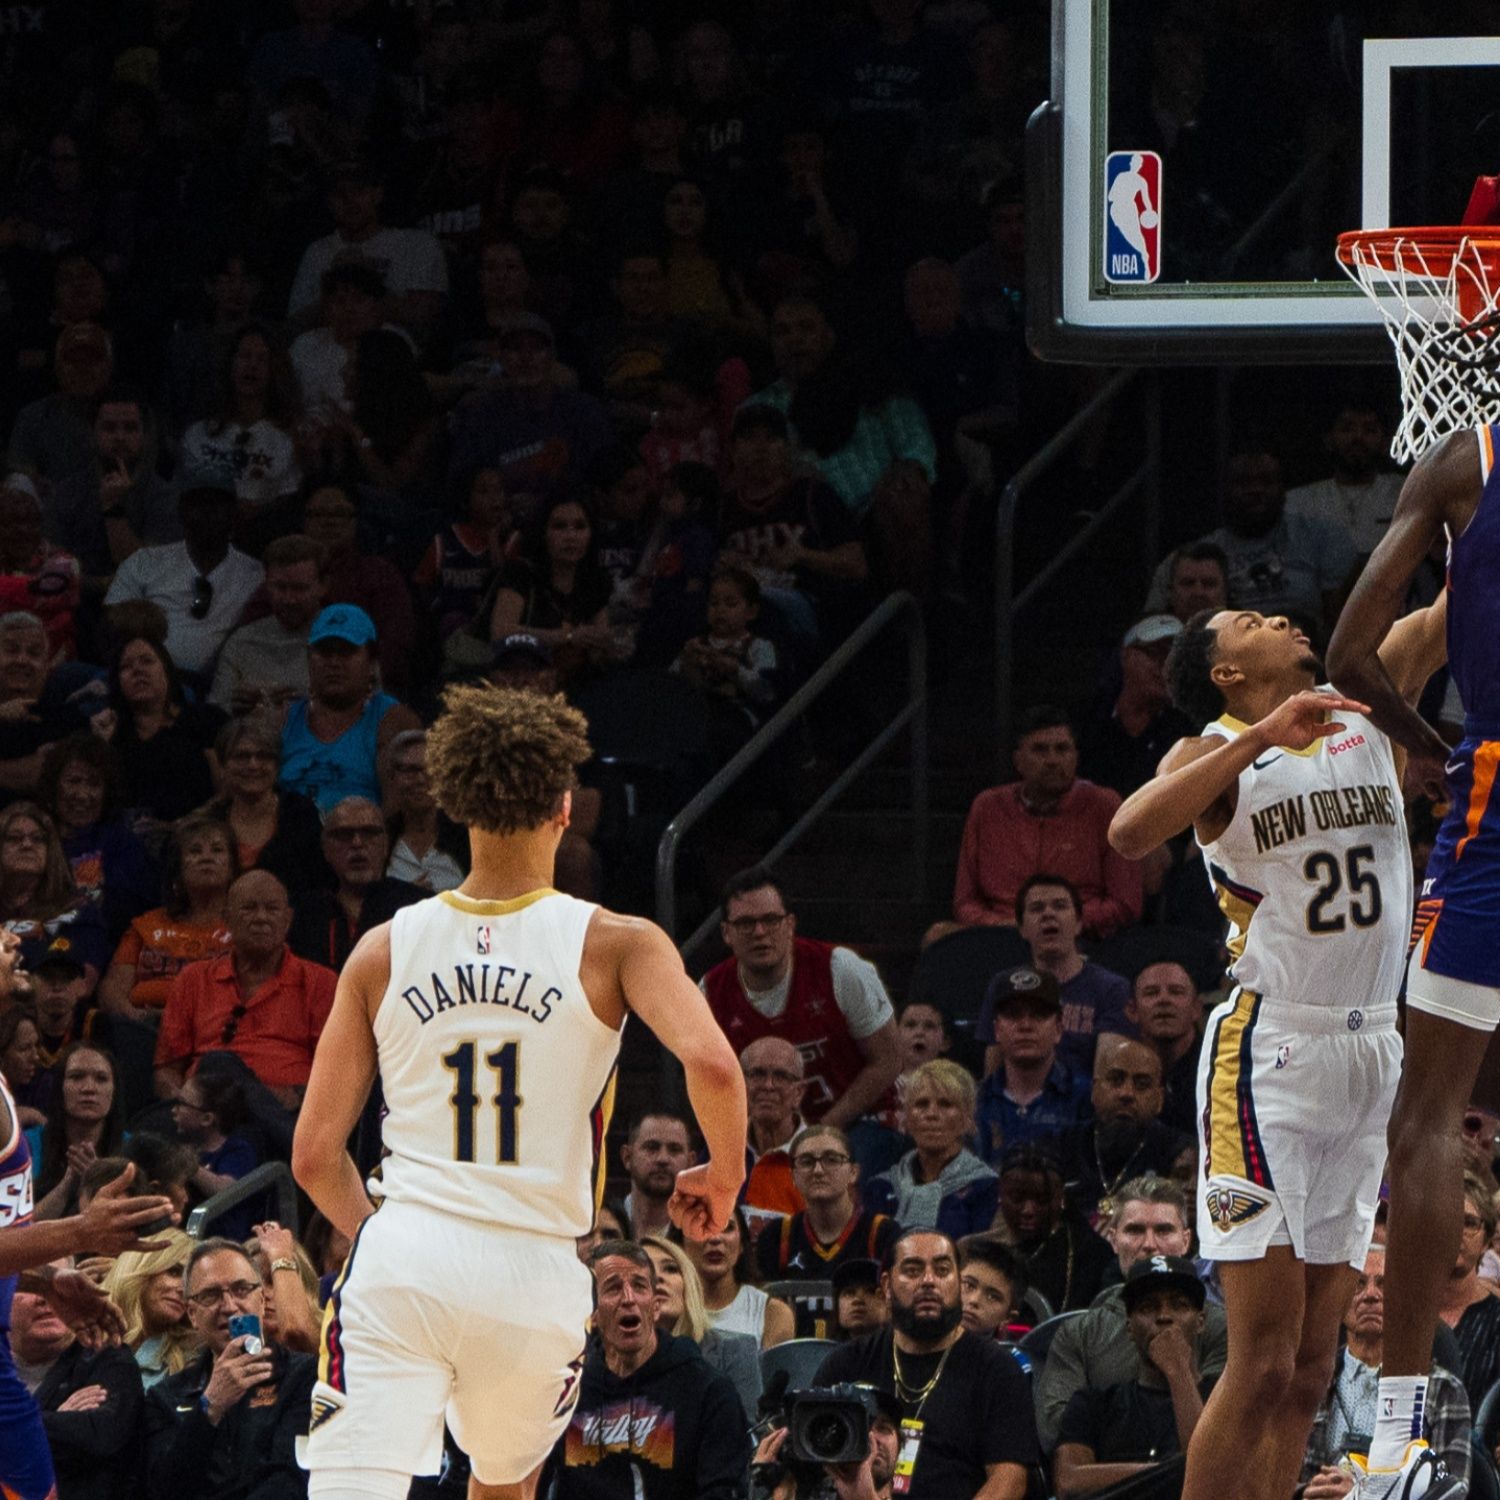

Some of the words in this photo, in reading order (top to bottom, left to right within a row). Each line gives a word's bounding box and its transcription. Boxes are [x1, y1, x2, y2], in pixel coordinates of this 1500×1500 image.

[1111, 253, 1139, 276] NBA
[1250, 796, 1307, 855] NEW
[1311, 783, 1397, 831] ORLEANS
[1302, 845, 1383, 934] 25
[402, 964, 563, 1025] DANIELS
[441, 1038, 523, 1166] 11
